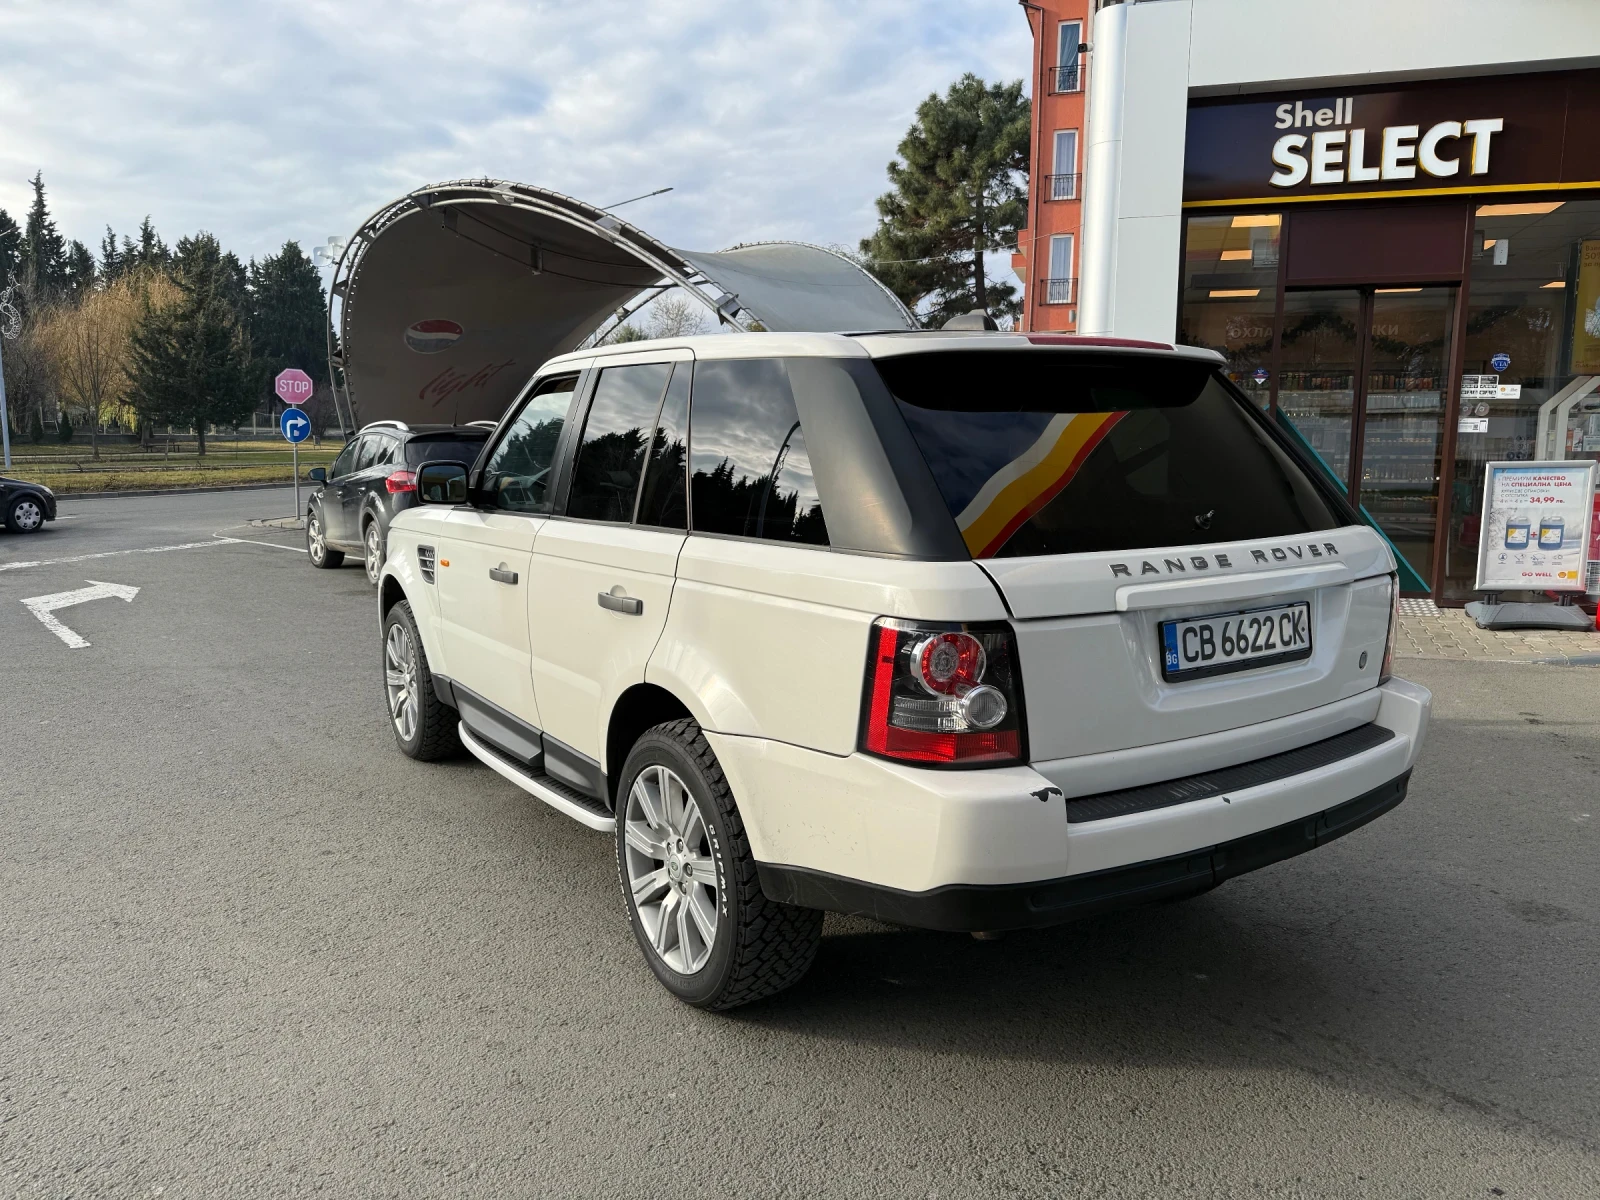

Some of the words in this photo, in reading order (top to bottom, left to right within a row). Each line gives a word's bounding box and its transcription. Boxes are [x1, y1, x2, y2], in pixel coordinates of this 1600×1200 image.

[1275, 98, 1354, 129] Shell
[1269, 117, 1504, 188] SELECT
[279, 379, 309, 394] STOP
[1108, 554, 1233, 578] RANGE
[1249, 543, 1340, 564] ROVER
[1182, 624, 1217, 663] CB
[1221, 615, 1277, 657] 6622
[1278, 610, 1306, 647] CK
[1165, 652, 1178, 666] BG
[708, 824, 729, 918] GRIPMAX
